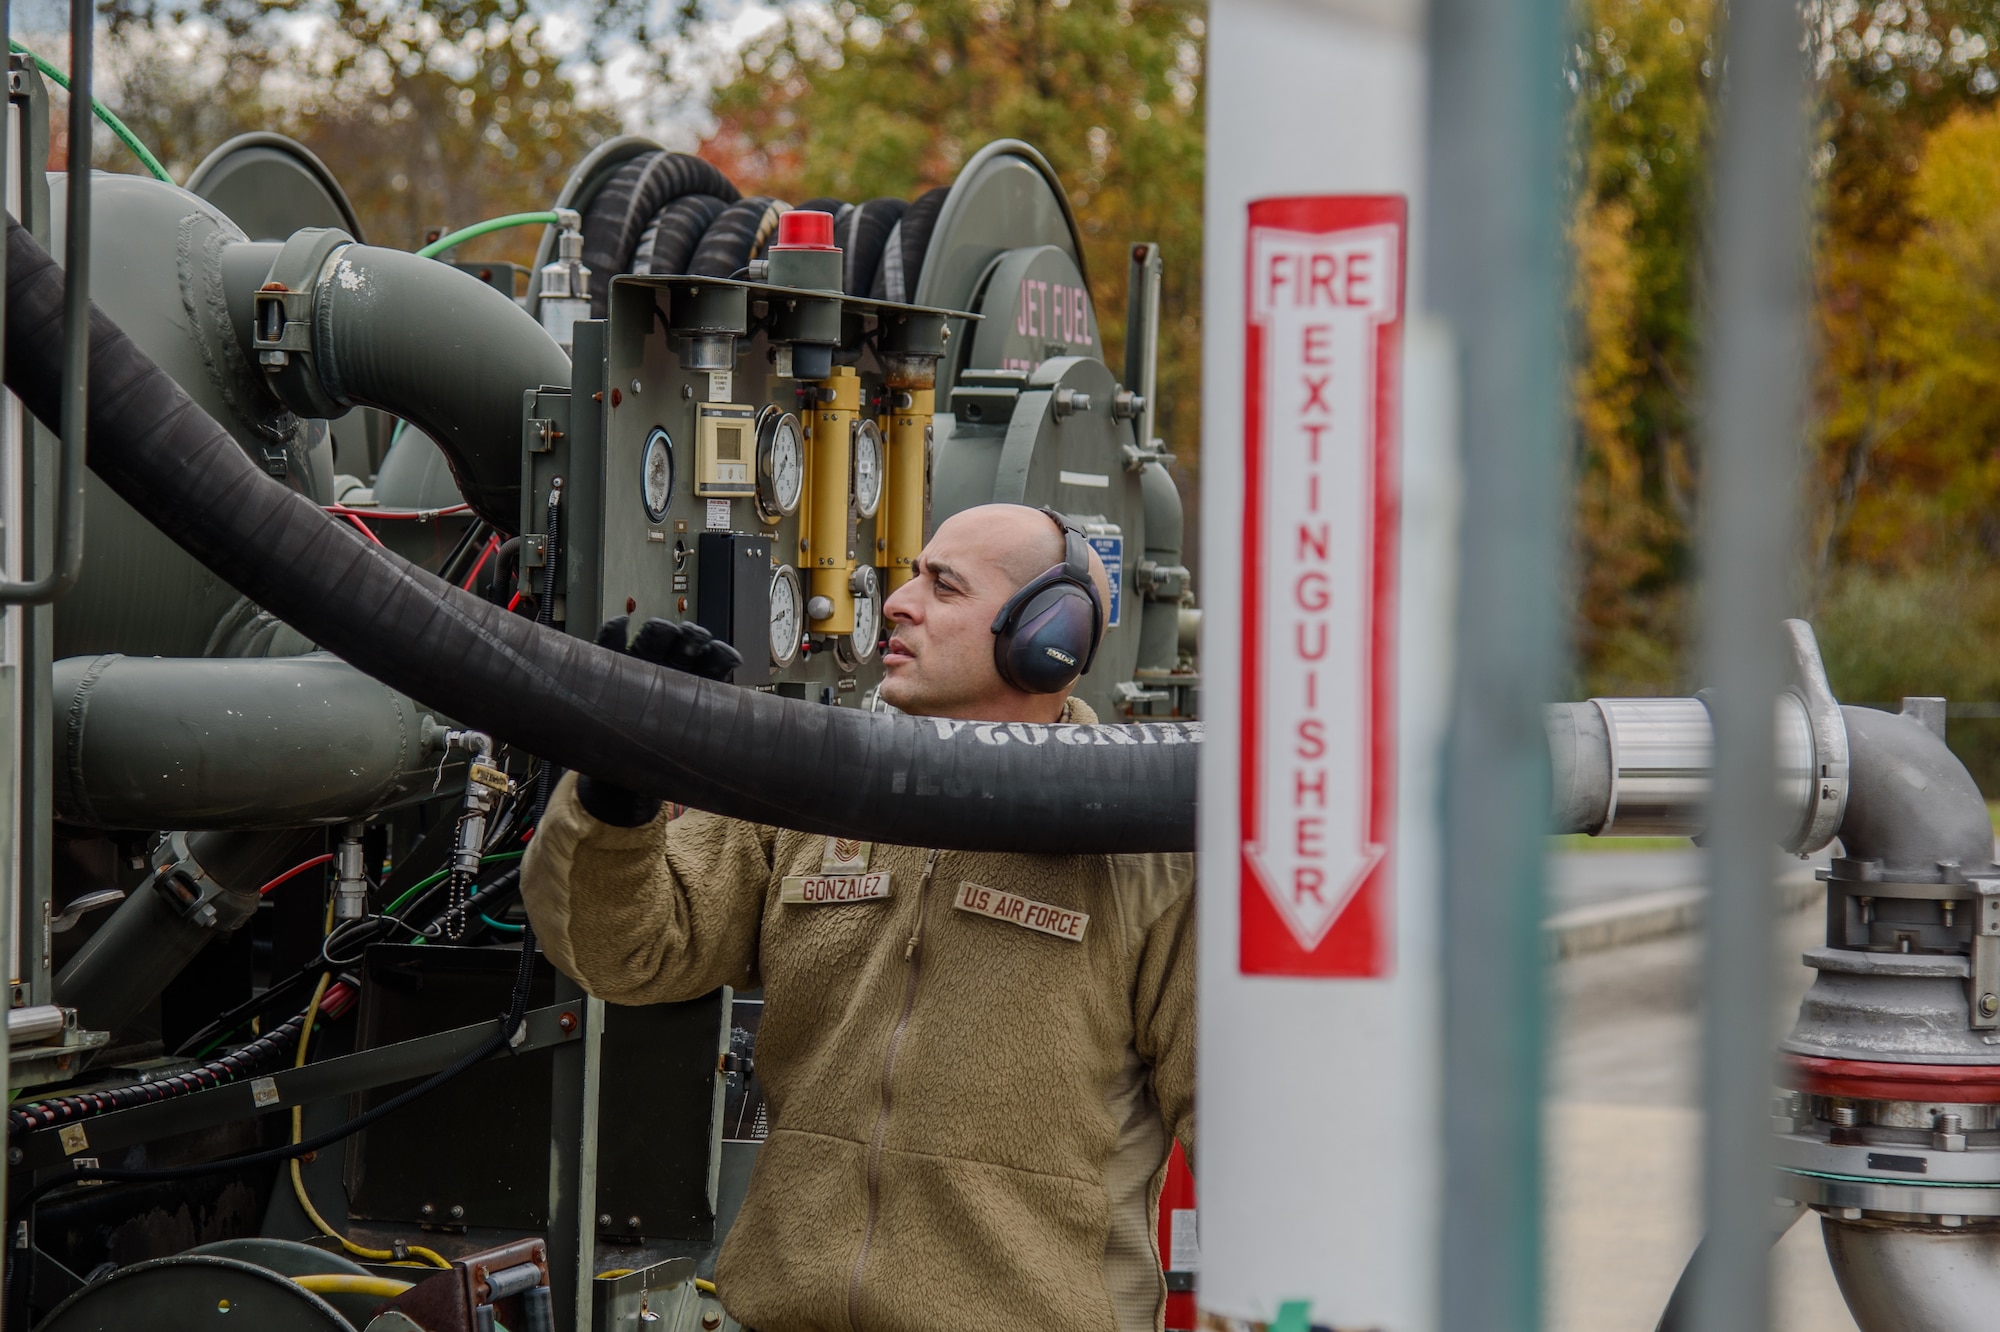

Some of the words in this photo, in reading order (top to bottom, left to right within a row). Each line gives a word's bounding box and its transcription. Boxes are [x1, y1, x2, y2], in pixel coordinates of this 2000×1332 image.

[1267, 252, 1374, 308] FIRE
[1017, 279, 1047, 338] JET
[1052, 283, 1092, 346] FUEL
[1292, 324, 1333, 906] EXTINGUISHER
[1046, 648, 1075, 666] MOLDEX
[803, 876, 881, 901] GONZALEZ
[963, 886, 990, 913] U.S.
[994, 895, 1025, 923] AIR
[1025, 905, 1082, 937] FORCE
